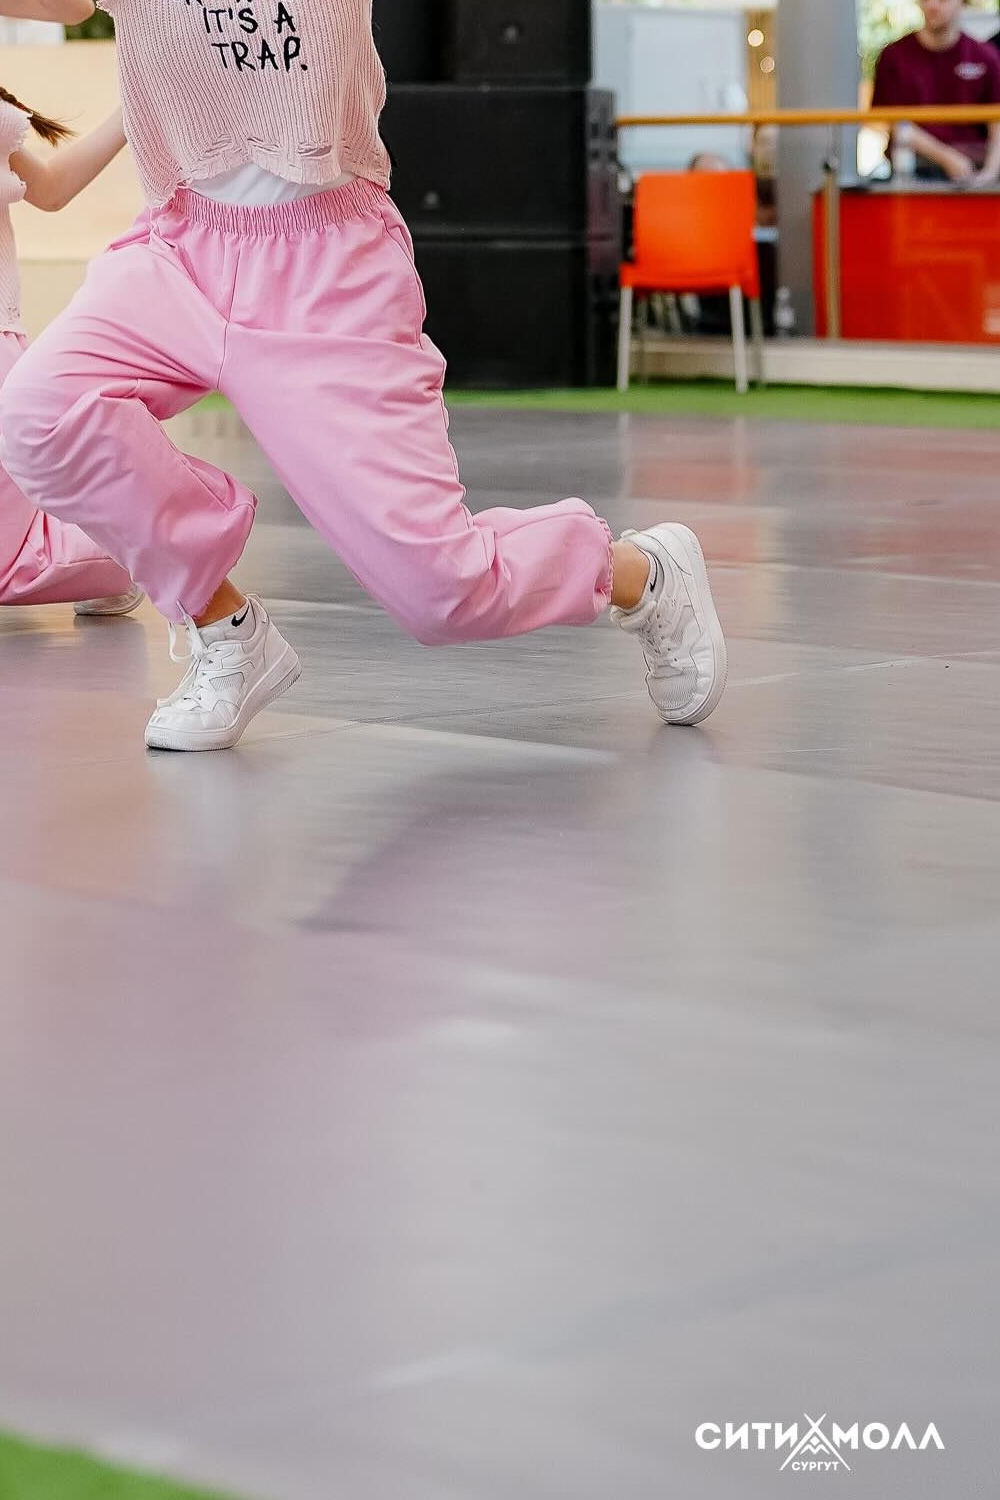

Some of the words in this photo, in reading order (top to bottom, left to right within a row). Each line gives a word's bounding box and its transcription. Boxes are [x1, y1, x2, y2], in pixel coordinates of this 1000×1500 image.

[203, 7, 258, 33] IT'S
[274, 2, 296, 33] A
[211, 36, 308, 73] TRAP.
